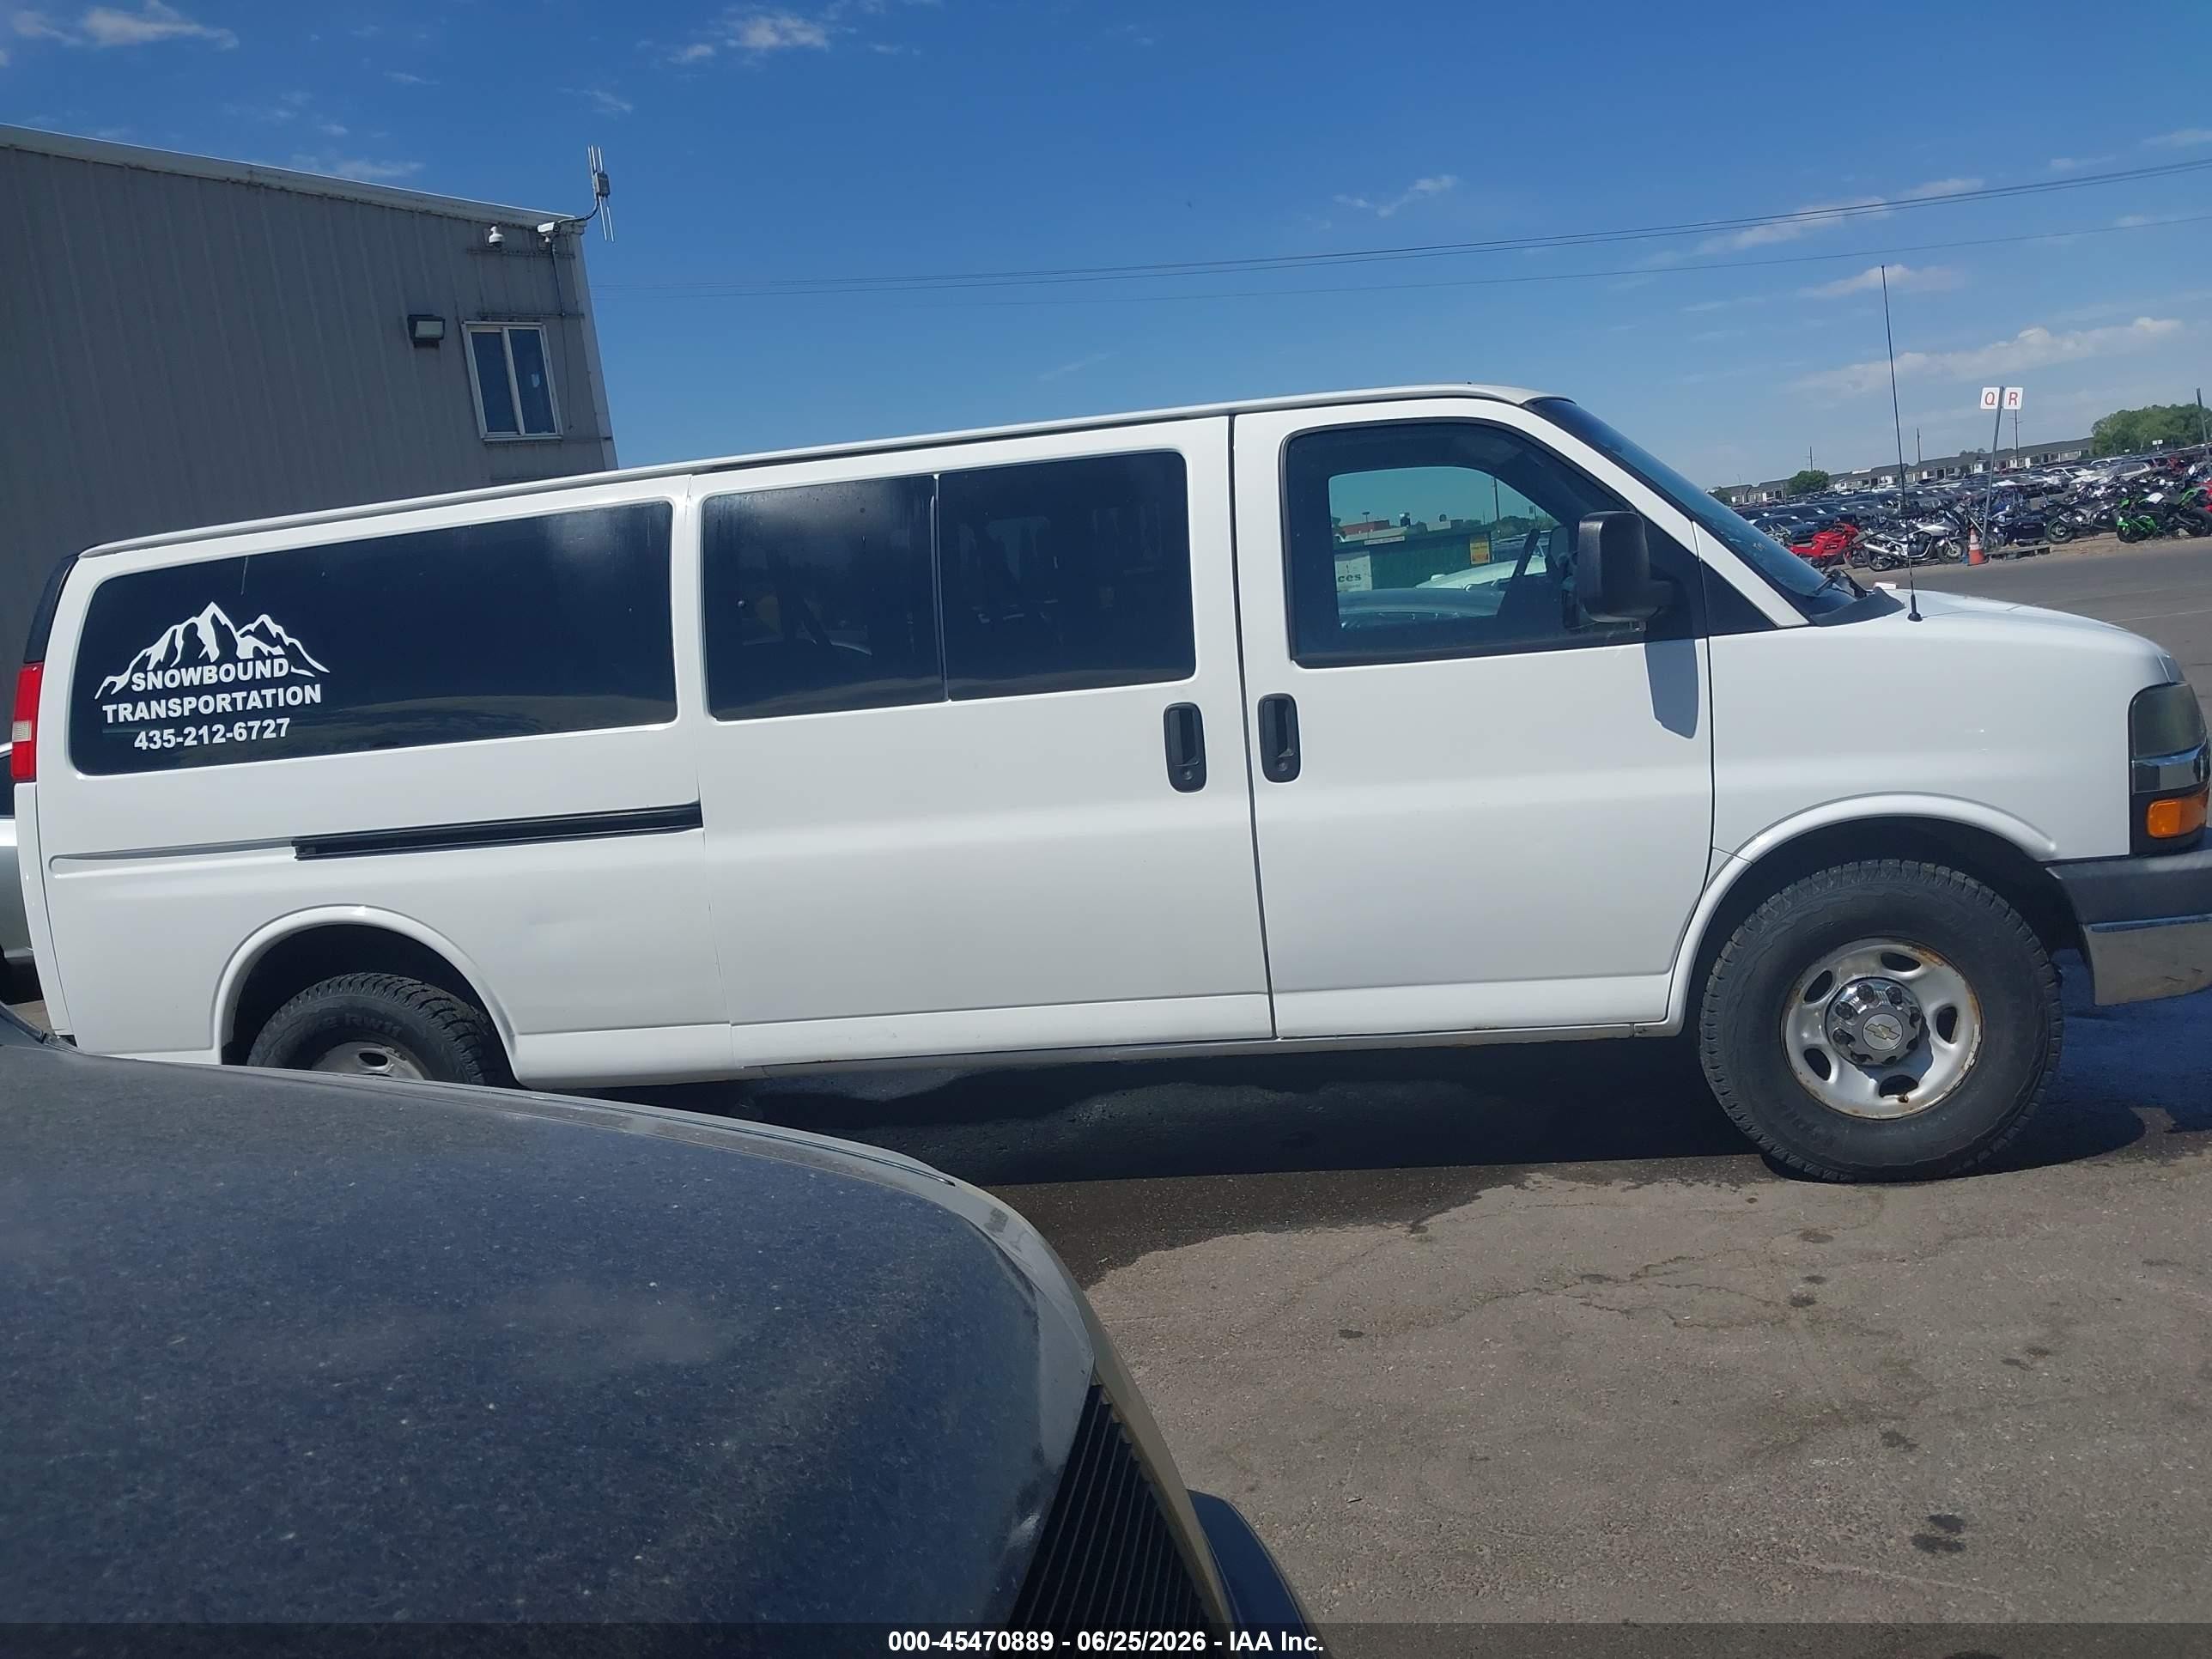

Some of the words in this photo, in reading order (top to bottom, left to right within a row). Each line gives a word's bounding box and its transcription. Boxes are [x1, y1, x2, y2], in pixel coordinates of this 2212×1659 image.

[1984, 391, 1996, 406] Q
[2008, 392, 2019, 406] R
[131, 658, 289, 691] SNOWBOUND
[102, 684, 321, 723] TRANSPORTATION
[134, 718, 290, 750] 435-212-6727
